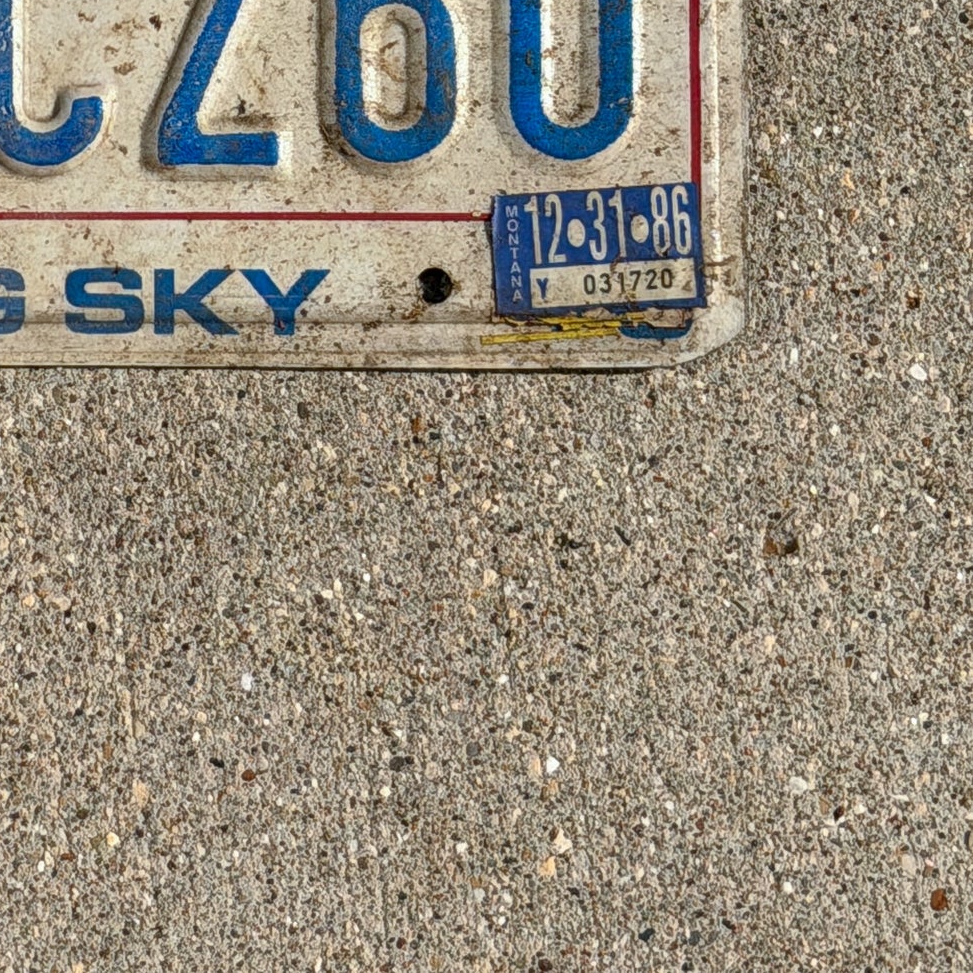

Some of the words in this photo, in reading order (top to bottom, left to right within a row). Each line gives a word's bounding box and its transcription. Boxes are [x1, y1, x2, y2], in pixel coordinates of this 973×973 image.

[505, 205, 524, 303] MONTANA
[583, 267, 673, 295] 031720
[64, 268, 327, 334] SKY
